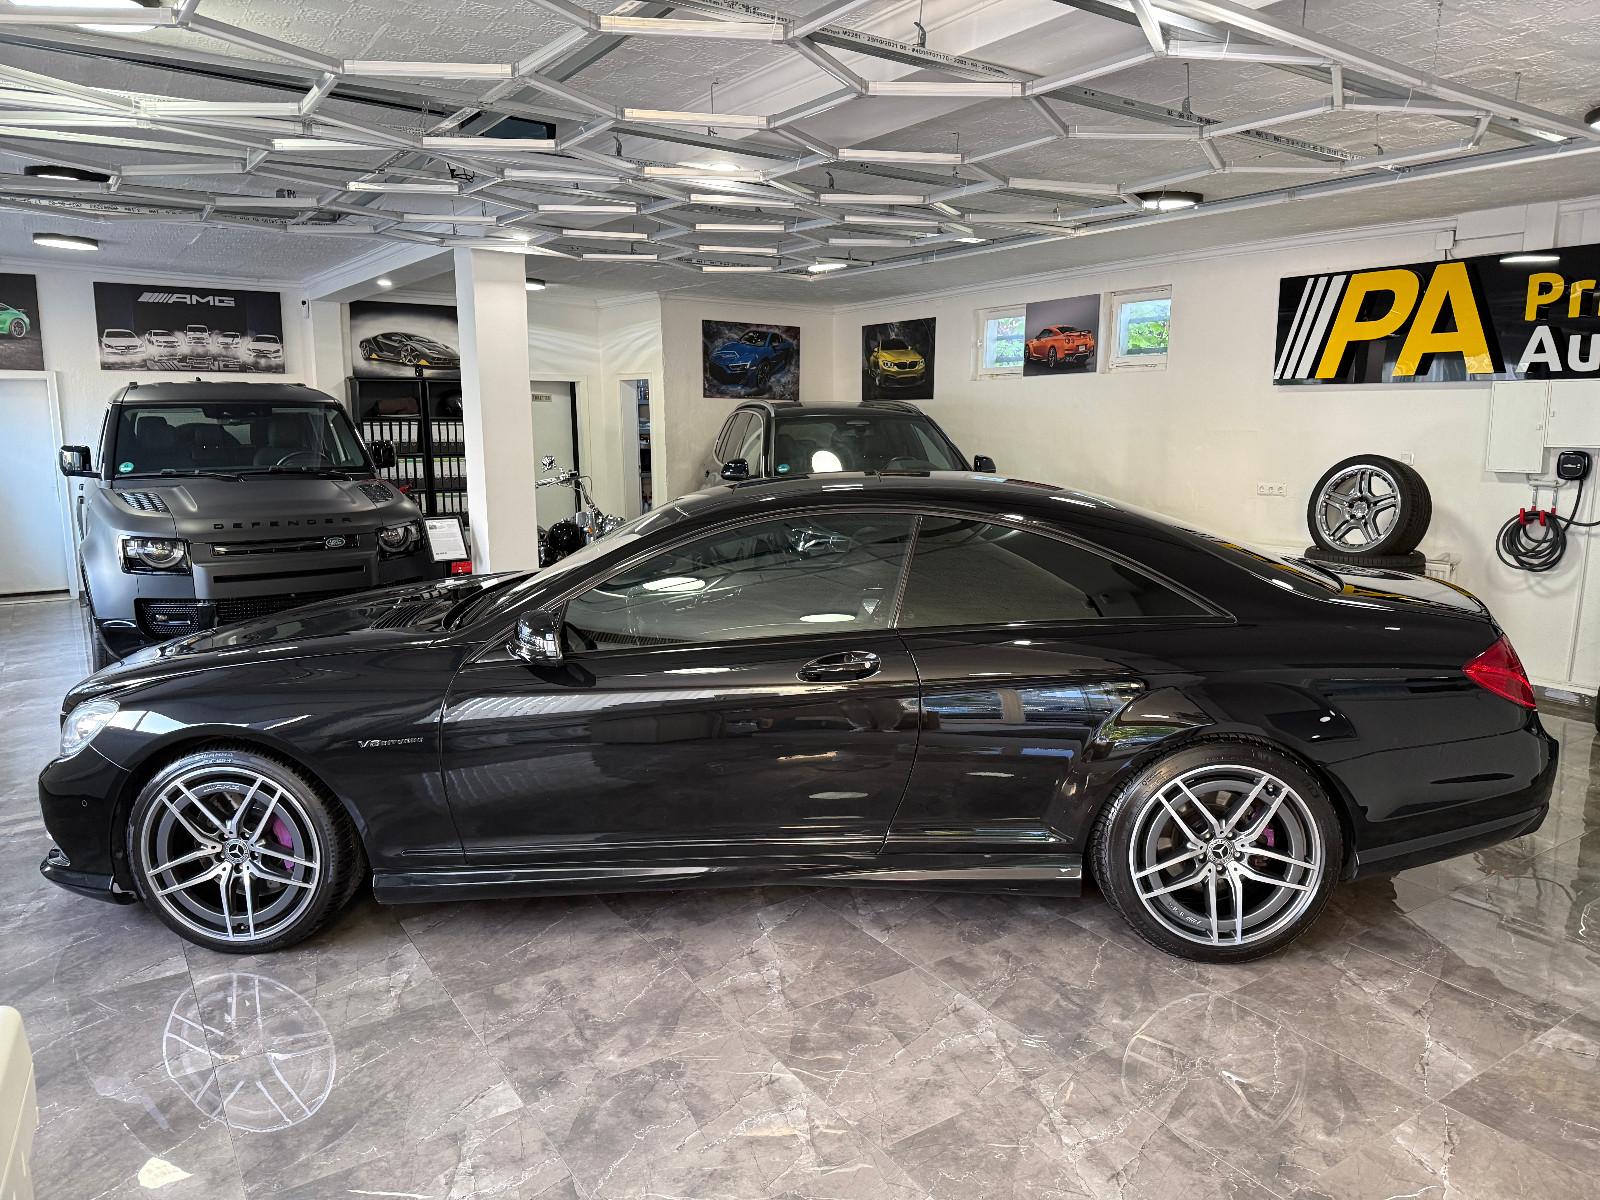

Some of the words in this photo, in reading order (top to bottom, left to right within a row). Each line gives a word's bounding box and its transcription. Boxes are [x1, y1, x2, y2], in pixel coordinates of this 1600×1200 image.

[1314, 262, 1495, 379] PA
[1525, 272, 1600, 321] Pr
[1515, 325, 1600, 372] Au
[213, 517, 353, 530] DEFENDER
